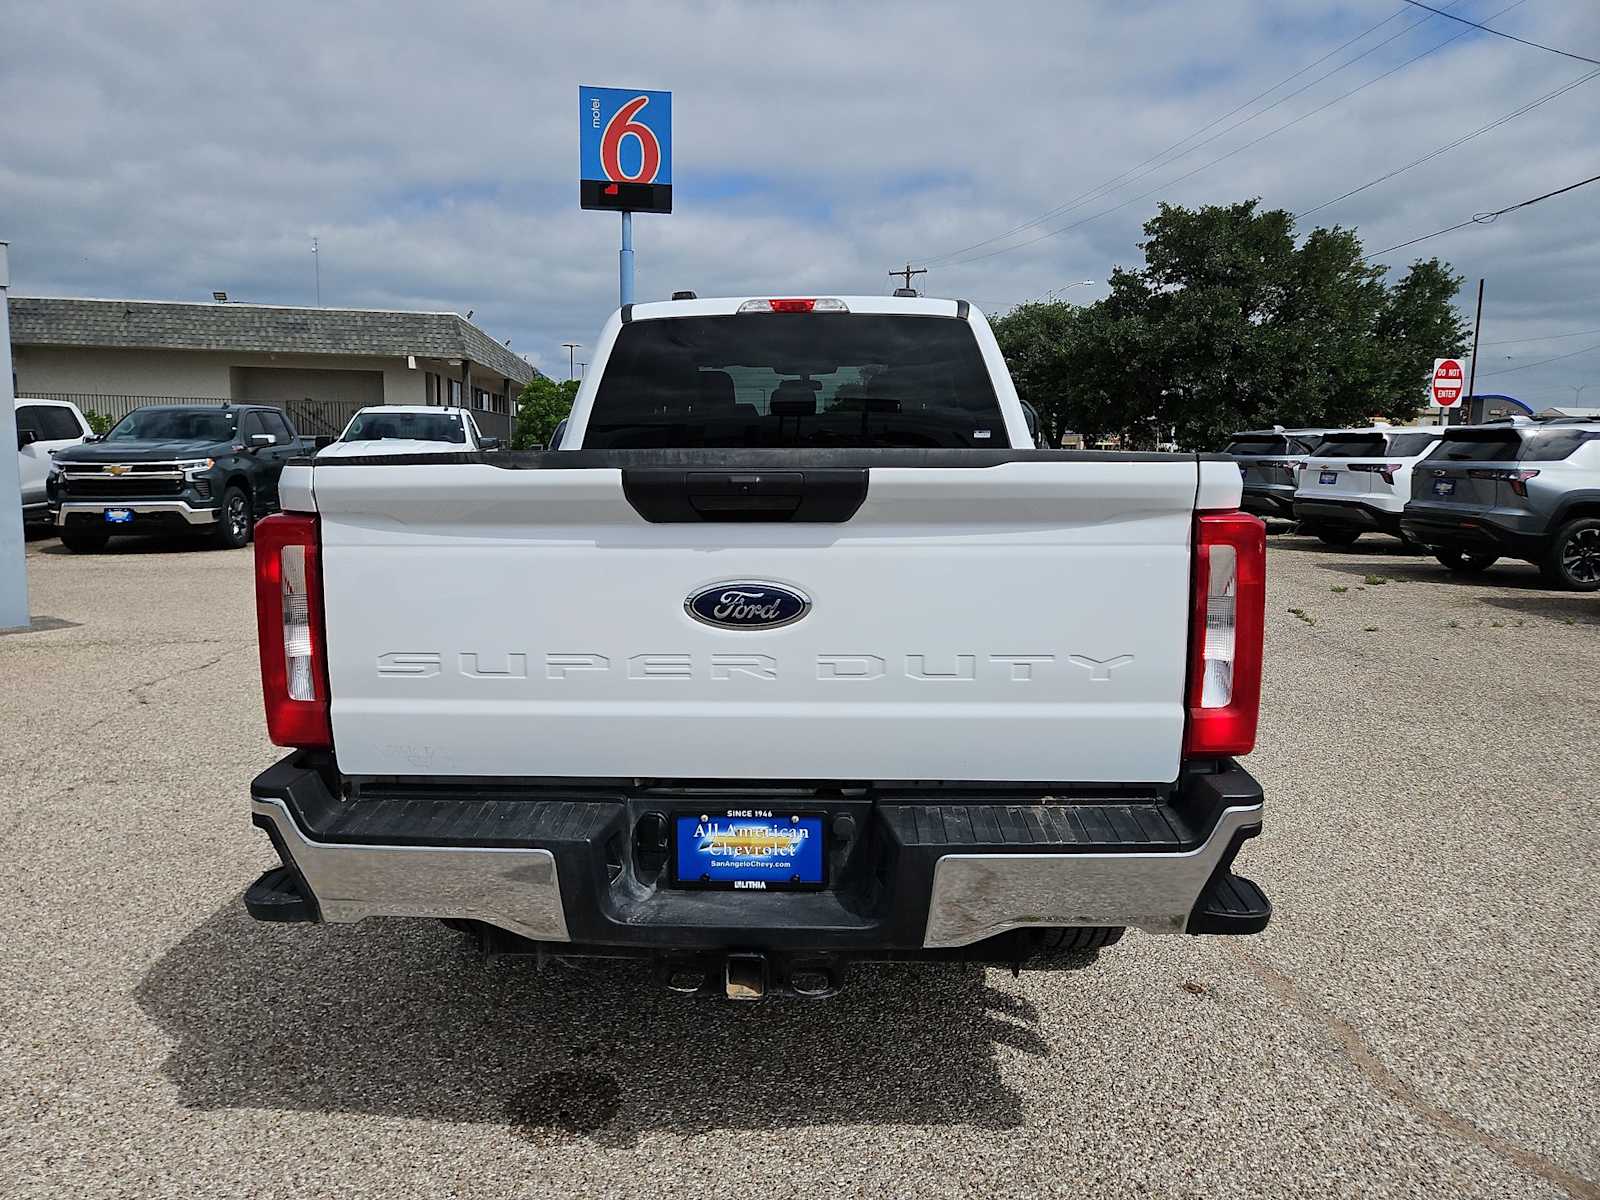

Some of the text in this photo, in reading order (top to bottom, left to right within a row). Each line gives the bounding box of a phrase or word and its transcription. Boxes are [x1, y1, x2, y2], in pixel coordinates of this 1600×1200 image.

[591, 97, 601, 129] motel
[599, 95, 662, 184] 6
[1437, 368, 1460, 377] DO NOT
[1437, 389, 1456, 398] ENTER
[713, 590, 780, 622] Ford
[376, 651, 1135, 683] SUPER DUTY
[727, 810, 773, 818] SINCE 1946
[693, 823, 809, 839] All American
[709, 841, 797, 857] Chevrolet
[711, 860, 791, 869] SanAngeloChevy.com
